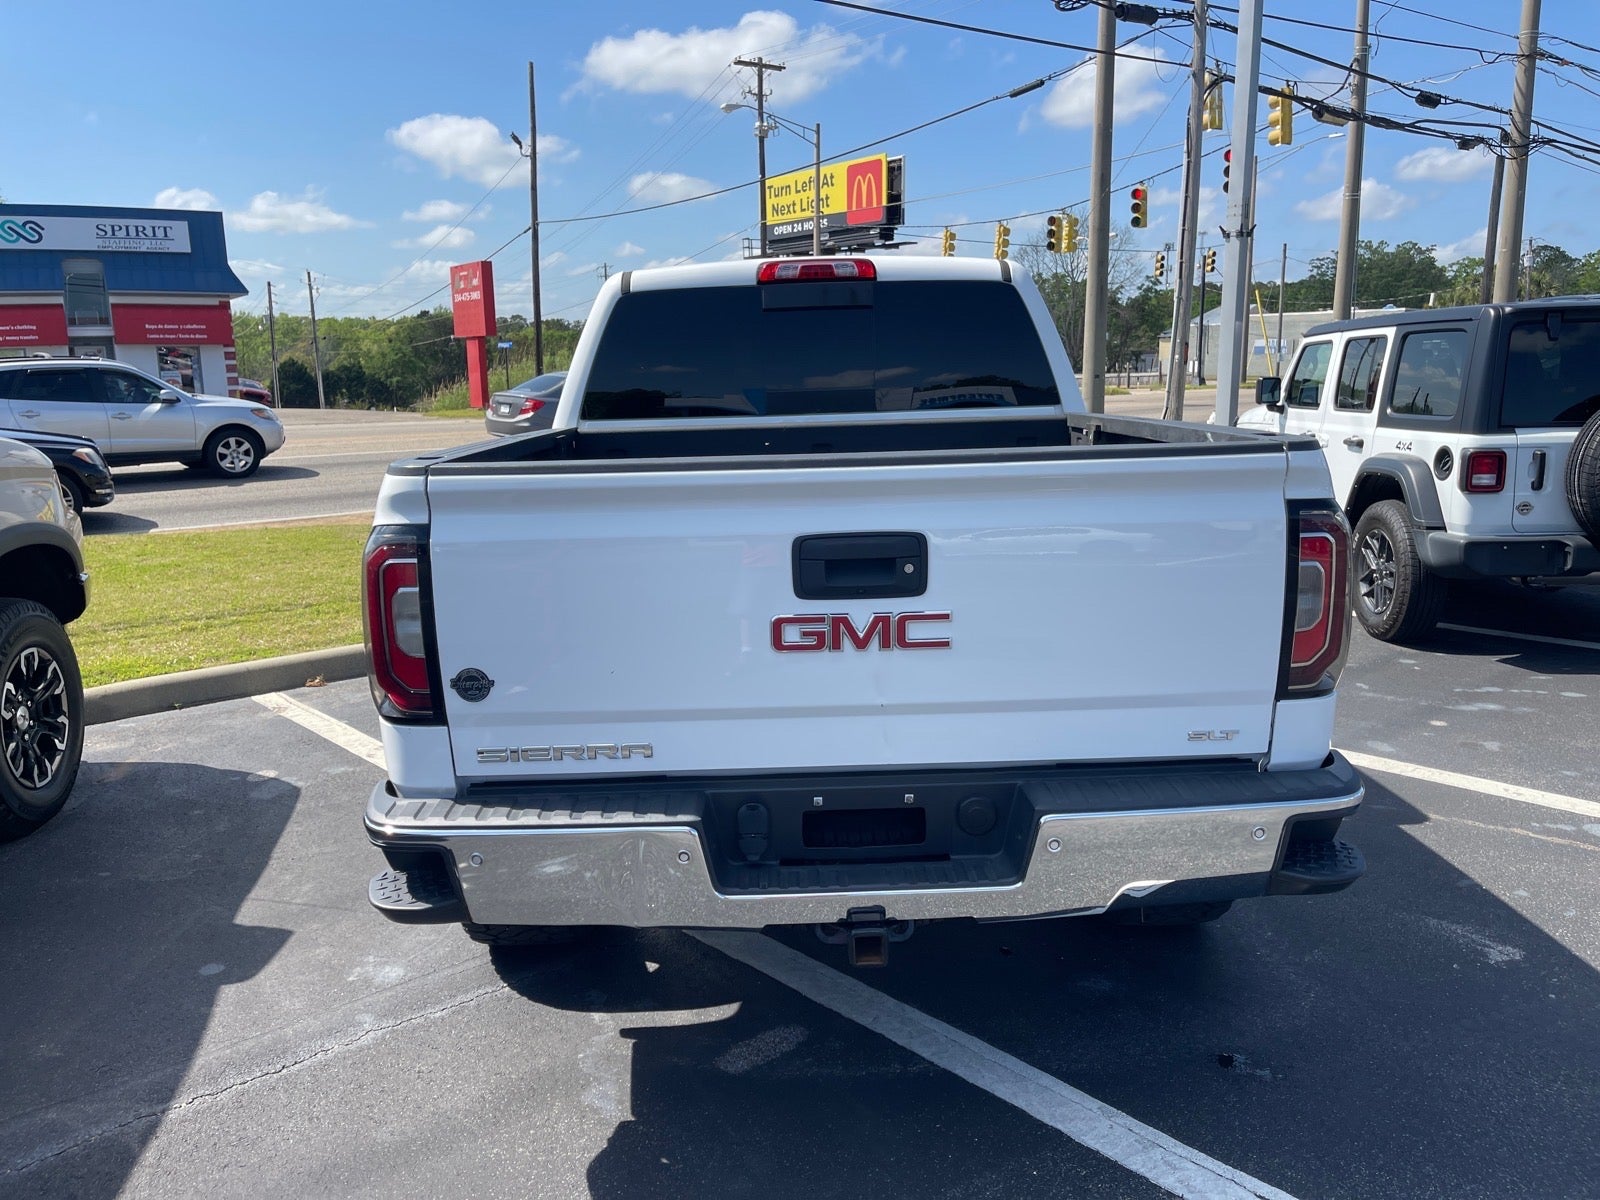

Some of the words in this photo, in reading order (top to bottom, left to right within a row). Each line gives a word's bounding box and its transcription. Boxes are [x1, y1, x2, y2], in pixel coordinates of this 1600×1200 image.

[767, 184, 791, 199] Turn
[821, 172, 835, 189] At
[771, 200, 797, 217] Next
[95, 223, 173, 238] SPIRIT
[773, 224, 792, 235] OPEN
[793, 222, 802, 232] 24
[803, 218, 828, 231] HOS
[771, 611, 951, 653] GMC
[1187, 729, 1240, 741] SLT
[477, 743, 653, 763] SIERRA
